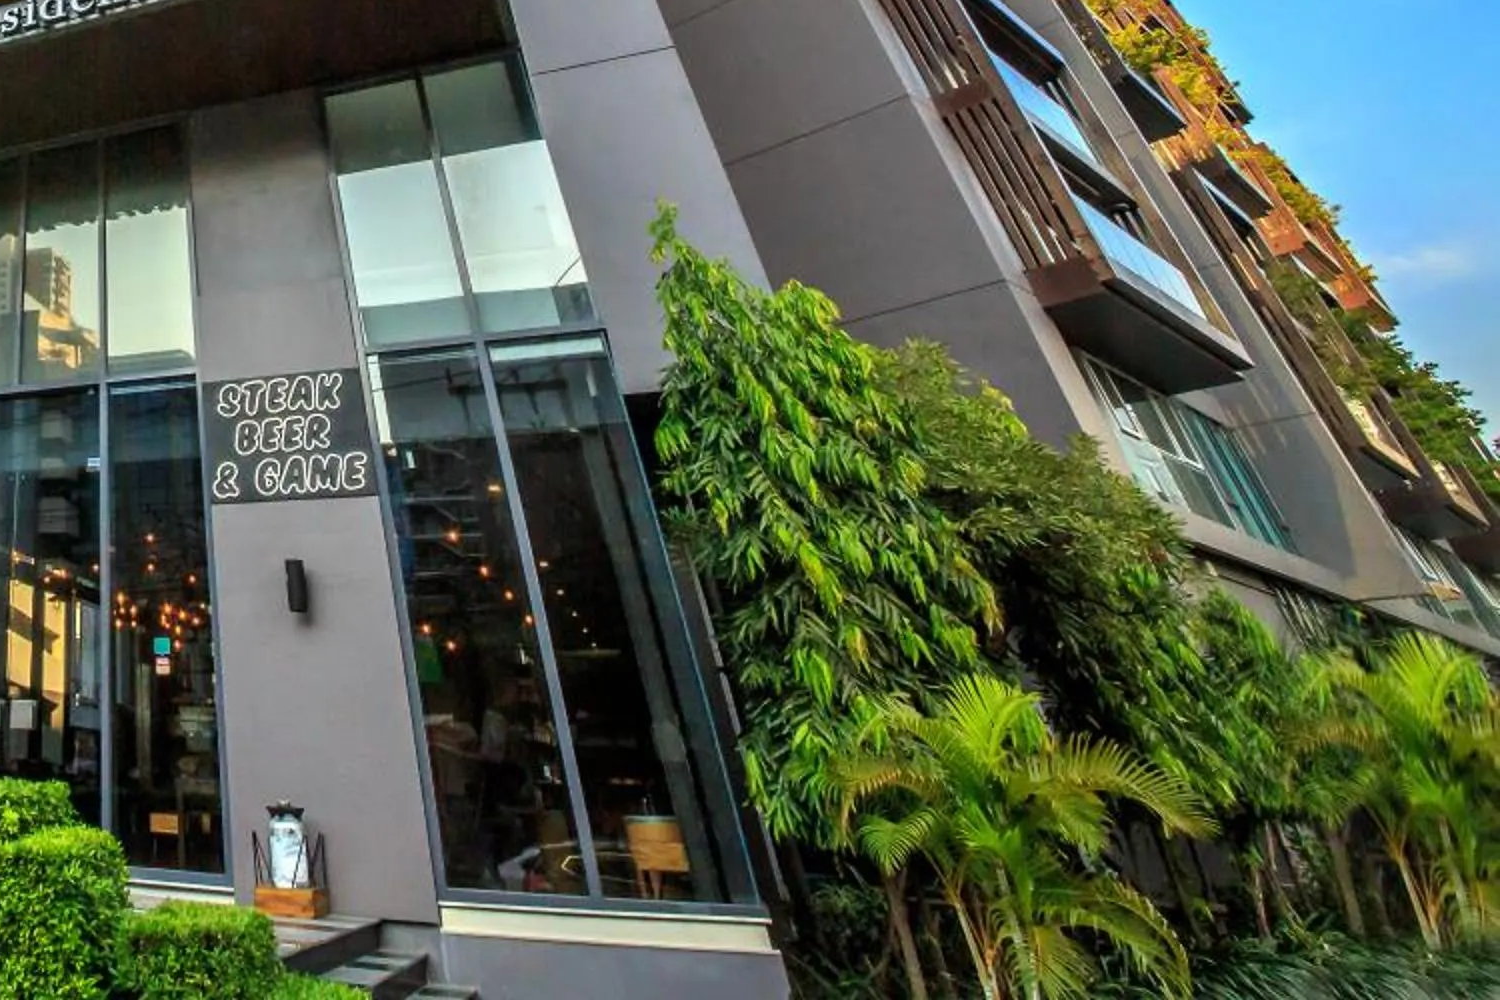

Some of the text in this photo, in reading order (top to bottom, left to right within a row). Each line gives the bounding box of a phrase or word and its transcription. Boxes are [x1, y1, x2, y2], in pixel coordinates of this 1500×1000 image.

[217, 373, 342, 417] STEAK
[235, 413, 330, 455] BEER
[213, 452, 367, 498] & GAME
